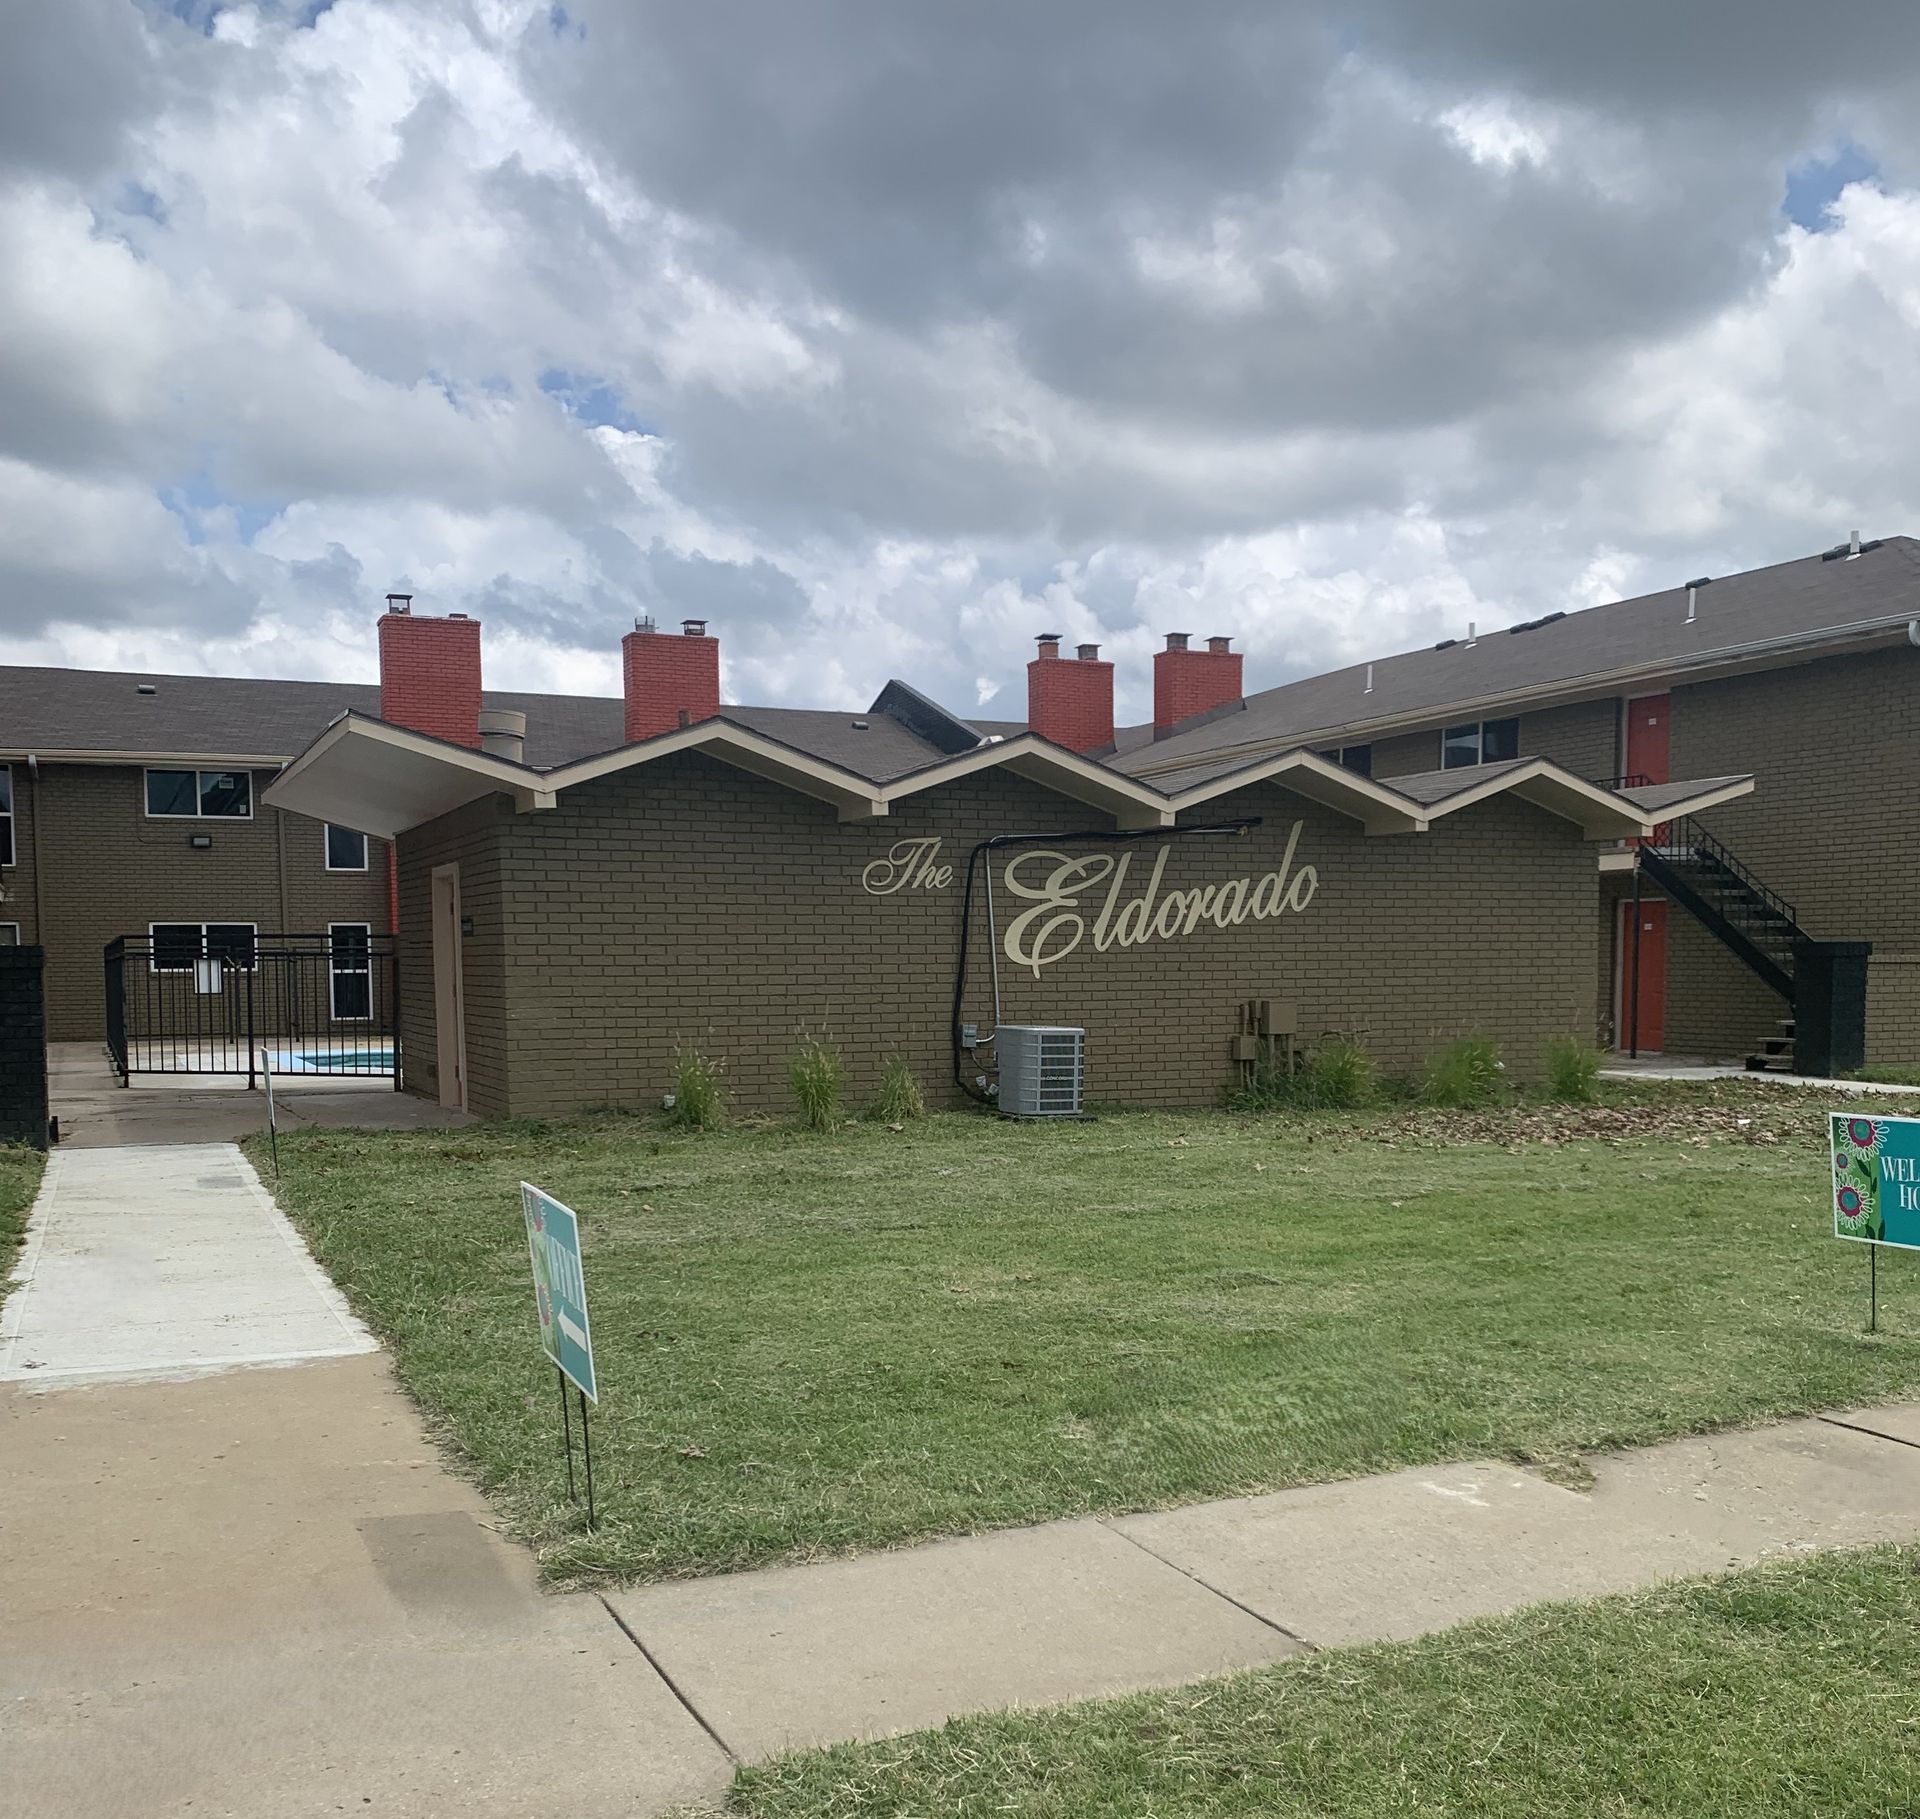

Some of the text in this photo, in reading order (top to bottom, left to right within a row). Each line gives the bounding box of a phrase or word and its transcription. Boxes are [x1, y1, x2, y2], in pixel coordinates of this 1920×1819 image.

[862, 819, 1319, 979] The Eldorado
[1880, 1155, 1920, 1182] WEL
